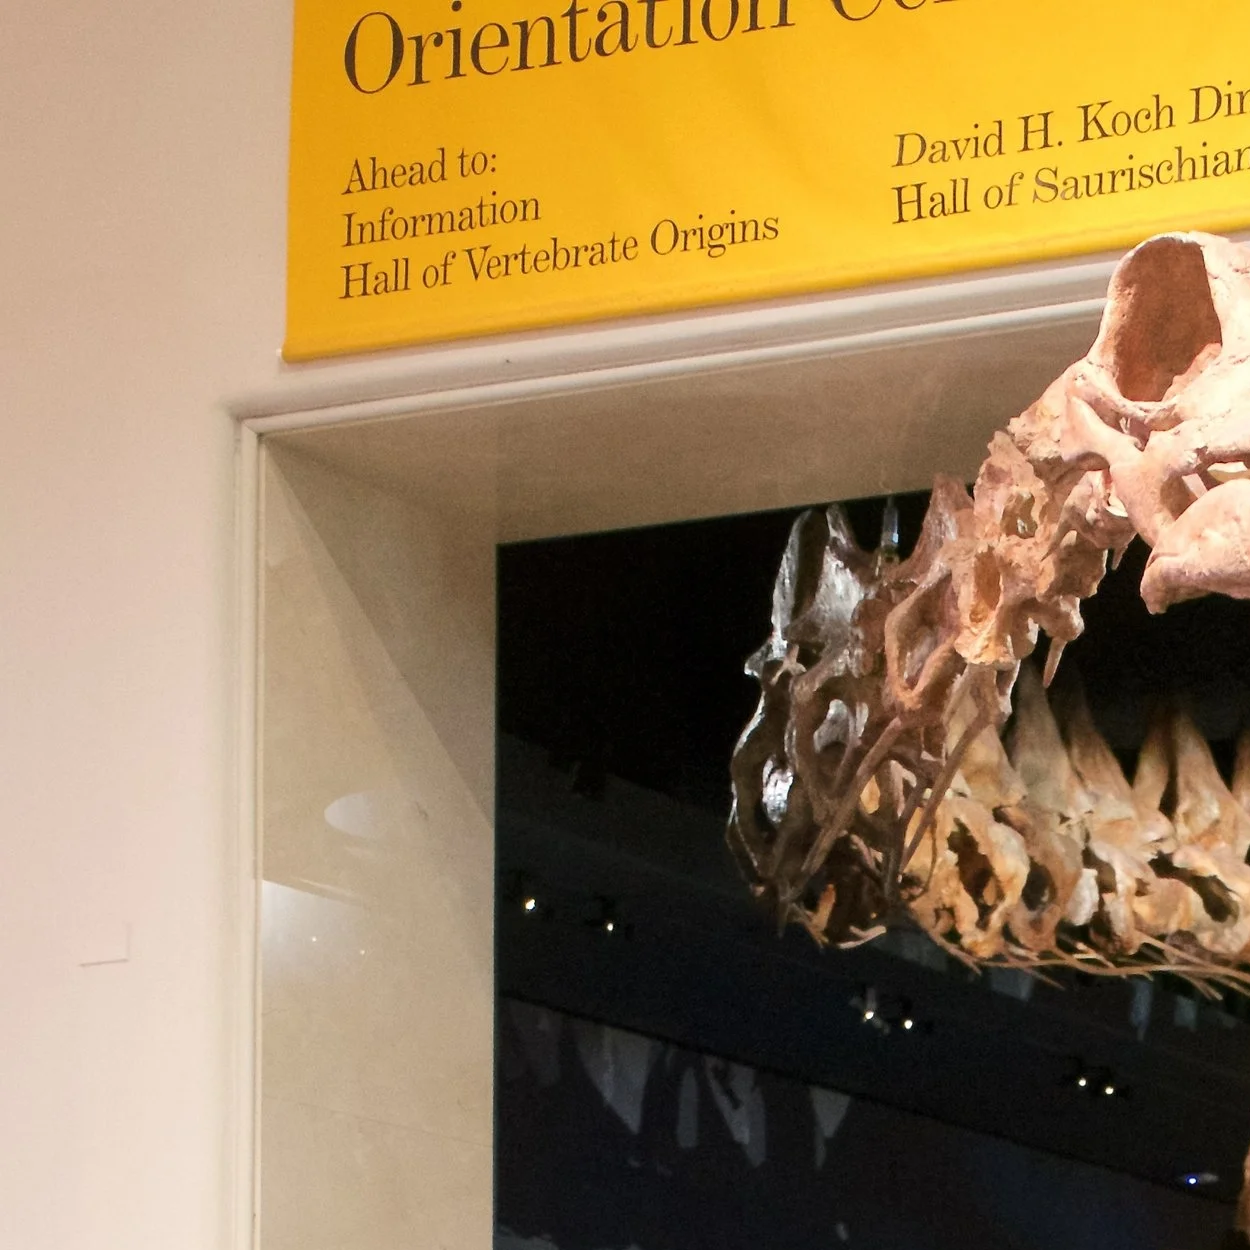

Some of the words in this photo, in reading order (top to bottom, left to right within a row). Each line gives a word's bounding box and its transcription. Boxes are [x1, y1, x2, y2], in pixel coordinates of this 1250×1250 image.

[892, 120, 1005, 167] David
[1018, 111, 1062, 152] H.
[1077, 94, 1175, 142] Koch
[343, 147, 447, 195] Ahead
[458, 148, 496, 177] to:
[891, 178, 970, 224] Hall
[984, 172, 1024, 209] of
[342, 193, 541, 247] Information
[339, 258, 410, 299] Hall
[423, 251, 456, 288] of
[462, 232, 638, 281] Vertebrate
[651, 210, 778, 258] Origins
